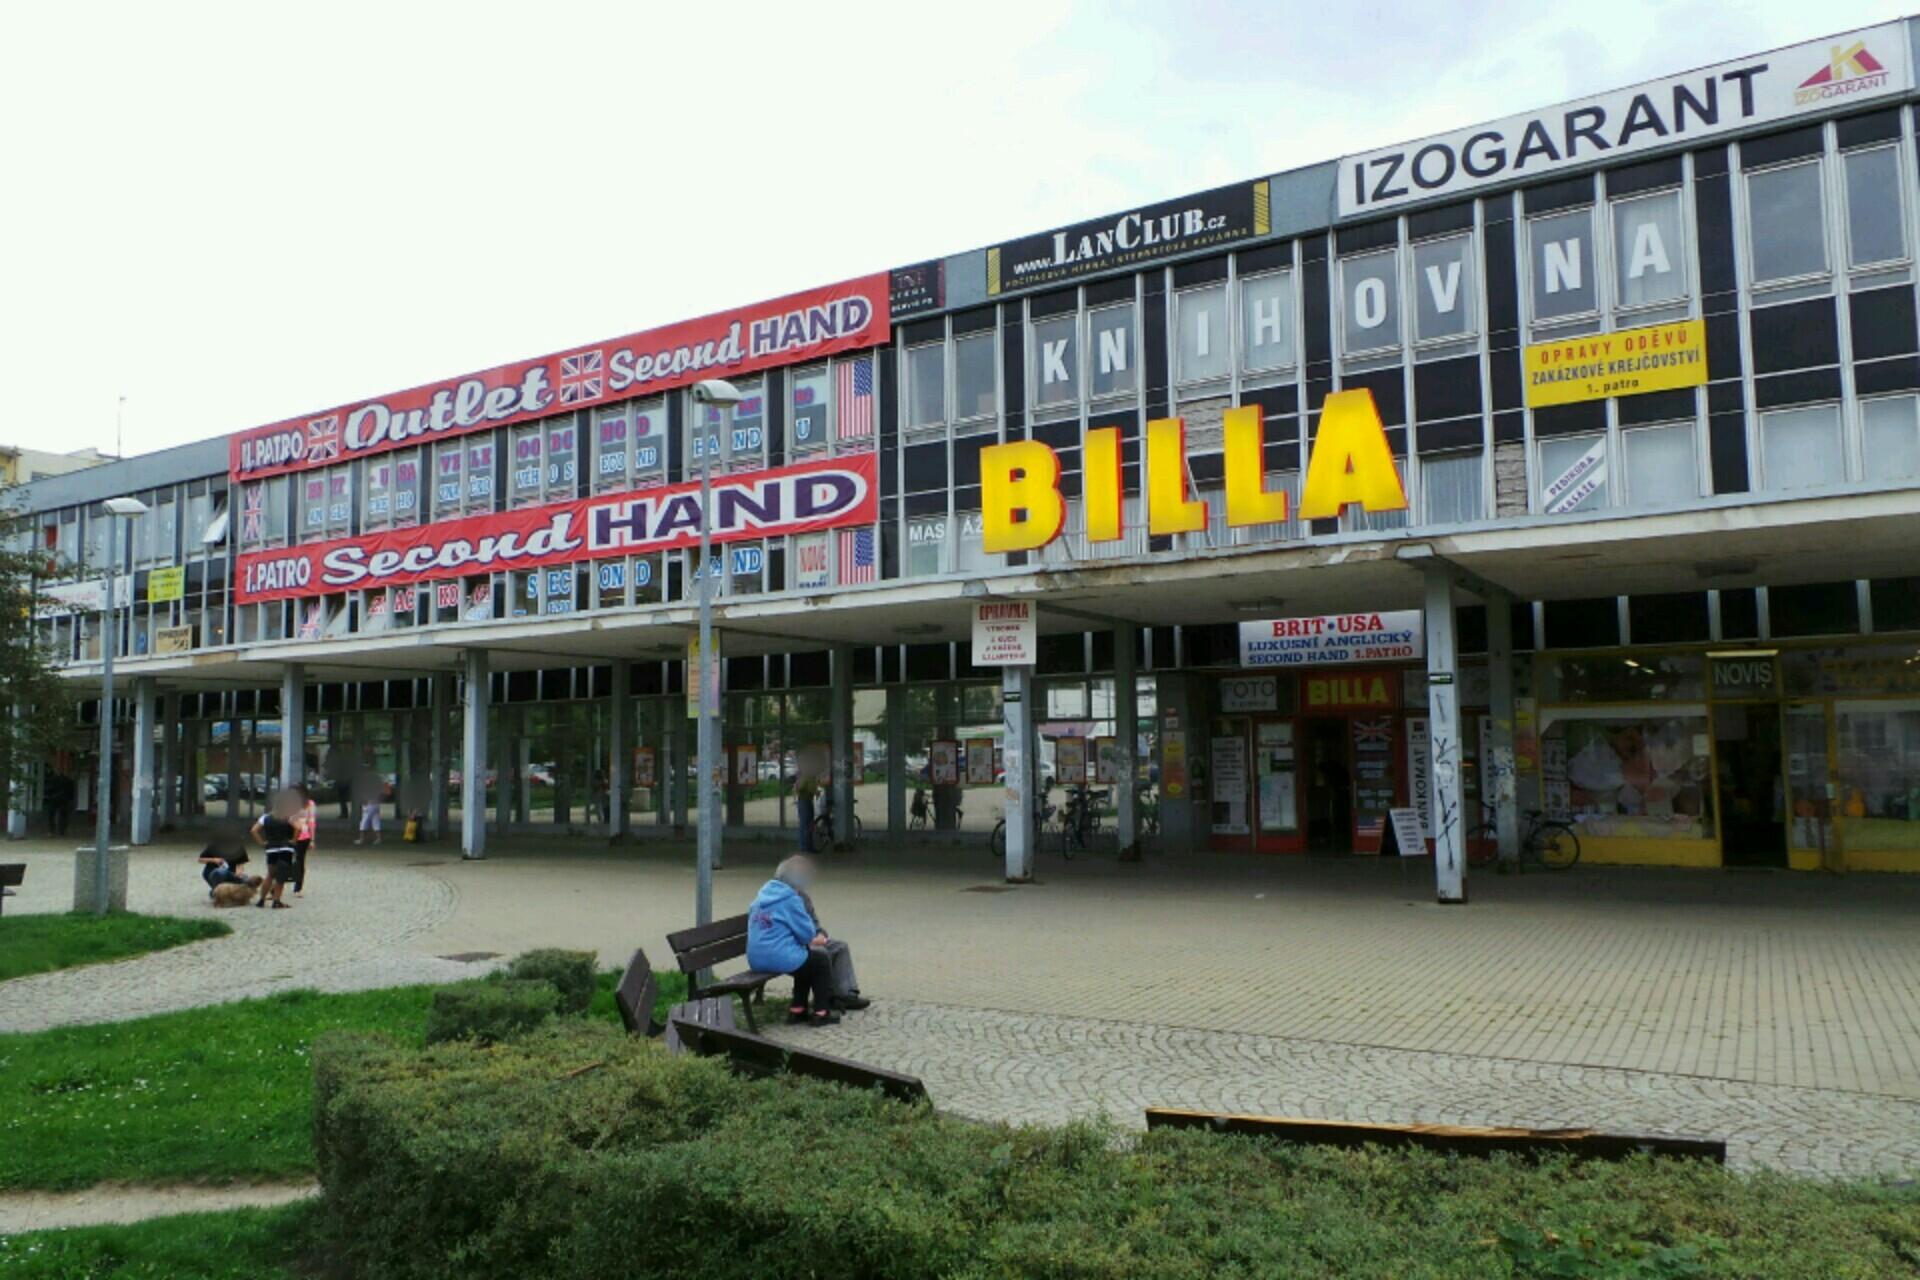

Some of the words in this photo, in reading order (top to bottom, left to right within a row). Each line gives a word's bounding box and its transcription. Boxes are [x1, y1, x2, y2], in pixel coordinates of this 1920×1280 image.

[1355, 63, 1769, 205] IZOGARANT
[1541, 340, 1612, 364] OPRAVY
[1625, 328, 1688, 353] ODĚVŮ
[343, 365, 556, 450] Outlet
[608, 320, 746, 392] Second
[749, 294, 873, 359] HAND
[1532, 361, 1605, 386] ZAKÁZKOVÉ
[1609, 344, 1700, 375] KREJČOVSTVÍ
[979, 387, 1409, 553] BILLA
[321, 510, 583, 585] Second
[587, 469, 868, 551] HAND
[1337, 613, 1384, 633] USA
[1248, 636, 1319, 653] LUXUSNÍ
[1324, 630, 1413, 648] ANGLICKÝ
[1248, 652, 1303, 665] SECOND
[1307, 649, 1349, 662] HAND
[1223, 680, 1275, 698] FOTO
[1307, 676, 1389, 706] BILLA
[1714, 661, 1773, 685] NOVIS
[1413, 749, 1429, 831] BANKOMAT
